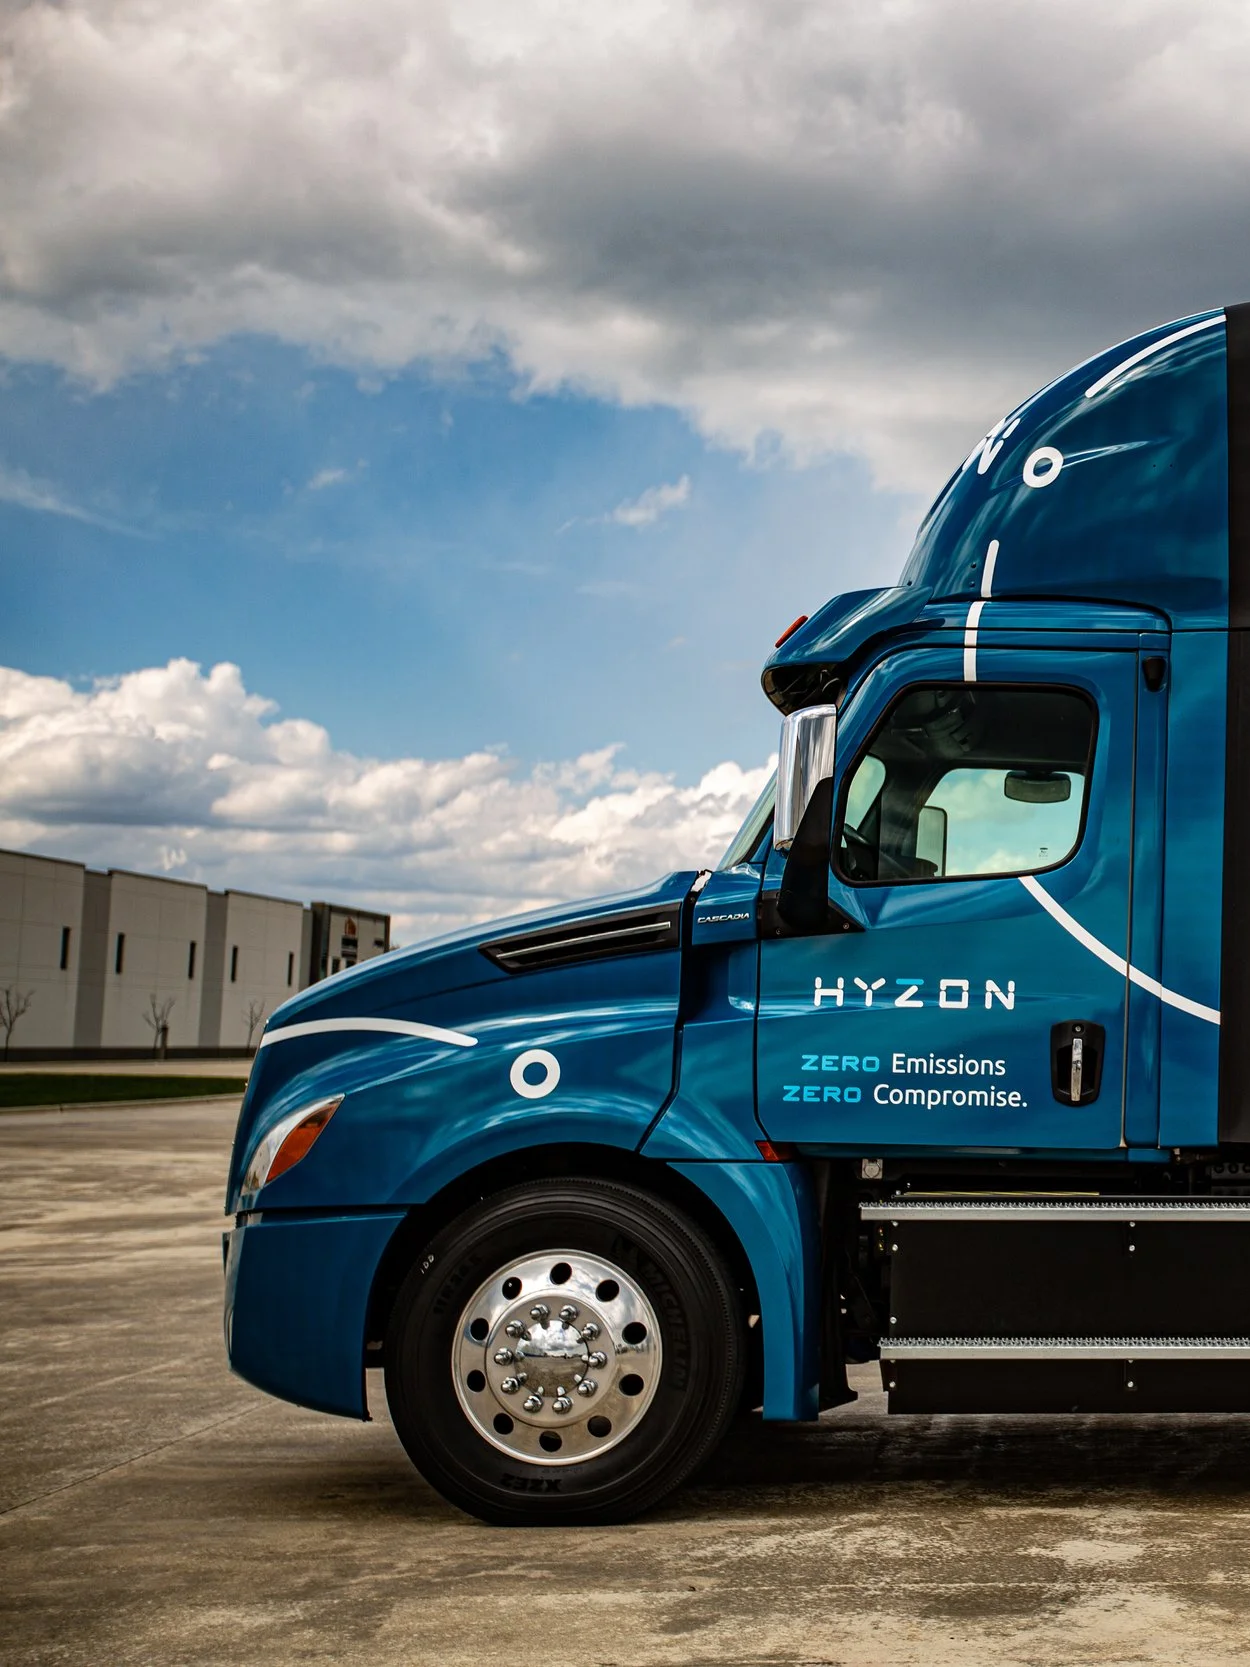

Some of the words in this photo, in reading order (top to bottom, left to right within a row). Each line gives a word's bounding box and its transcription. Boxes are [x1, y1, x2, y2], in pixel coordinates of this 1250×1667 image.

[697, 912, 750, 924] CASCADIA
[814, 976, 1015, 1010] HYZON
[801, 1054, 880, 1072] ZERO
[892, 1053, 1006, 1076] Emissions
[782, 1085, 862, 1103] ZERO
[873, 1084, 1028, 1110] Compromise.
[639, 1262, 687, 1390] MICHELIN
